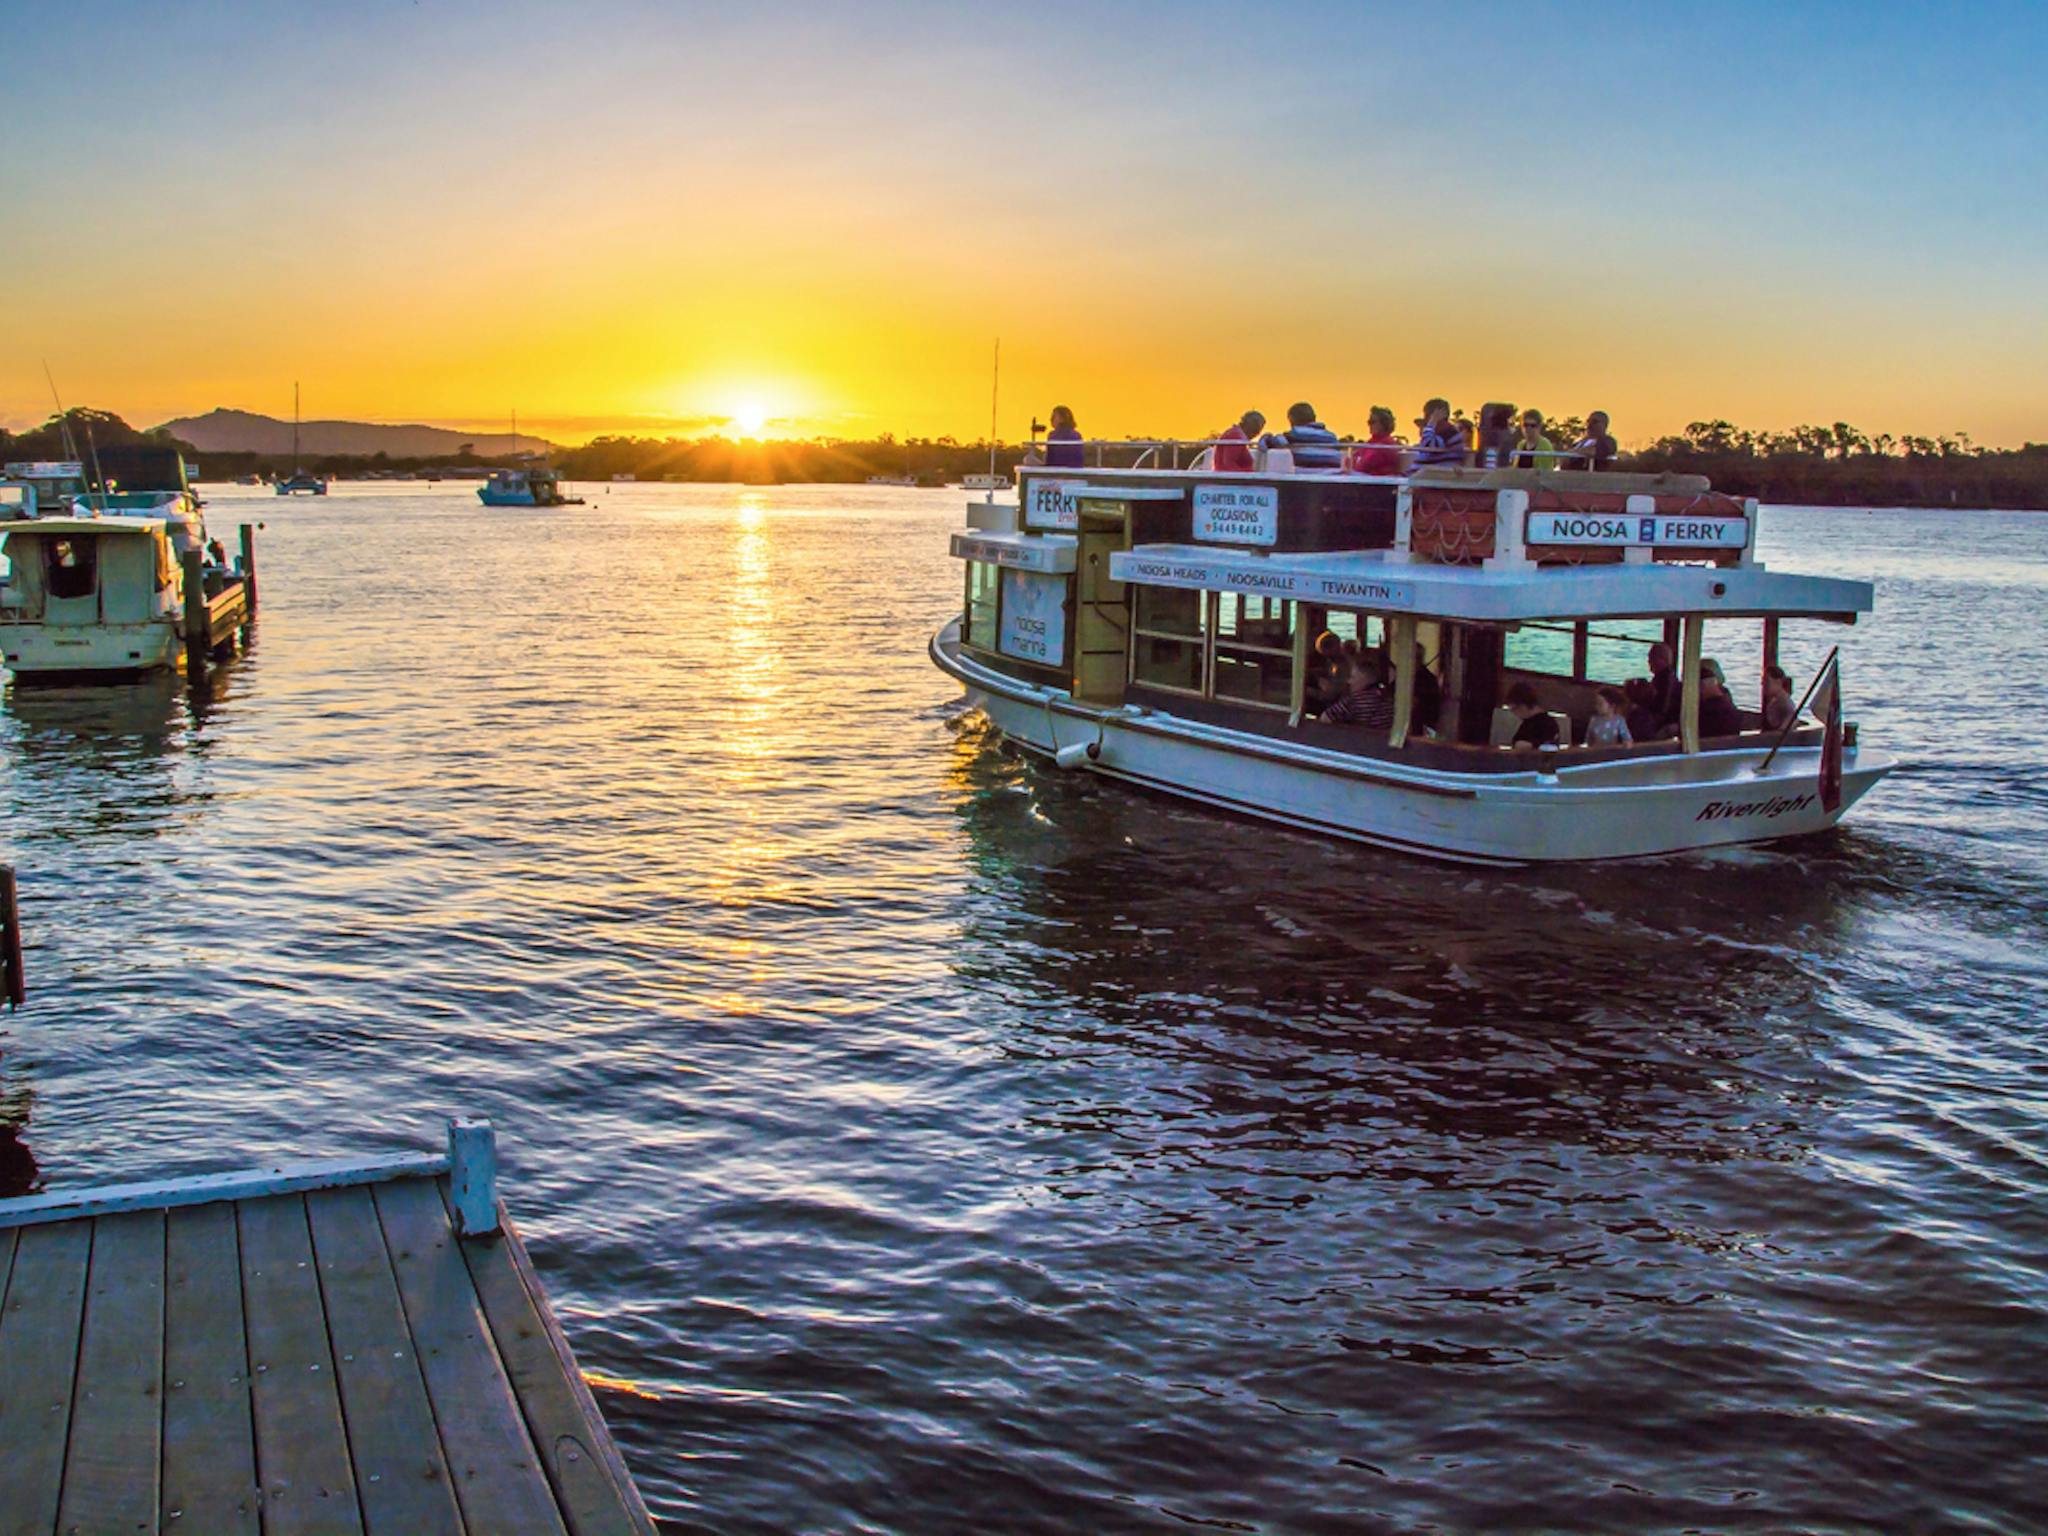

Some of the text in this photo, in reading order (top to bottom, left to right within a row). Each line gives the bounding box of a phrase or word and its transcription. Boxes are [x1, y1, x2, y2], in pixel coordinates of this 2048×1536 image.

[1037, 491, 1077, 512] FERR
[1200, 493, 1269, 507] CHARTER FOR ALL
[1211, 508, 1258, 522] OCCASIONS
[1552, 519, 1726, 540] NOOSA FERRY
[1136, 564, 1390, 599] NOOSA HEADS NOOSAVILLE TEWANTIN
[1696, 793, 1817, 822] Riverlight
